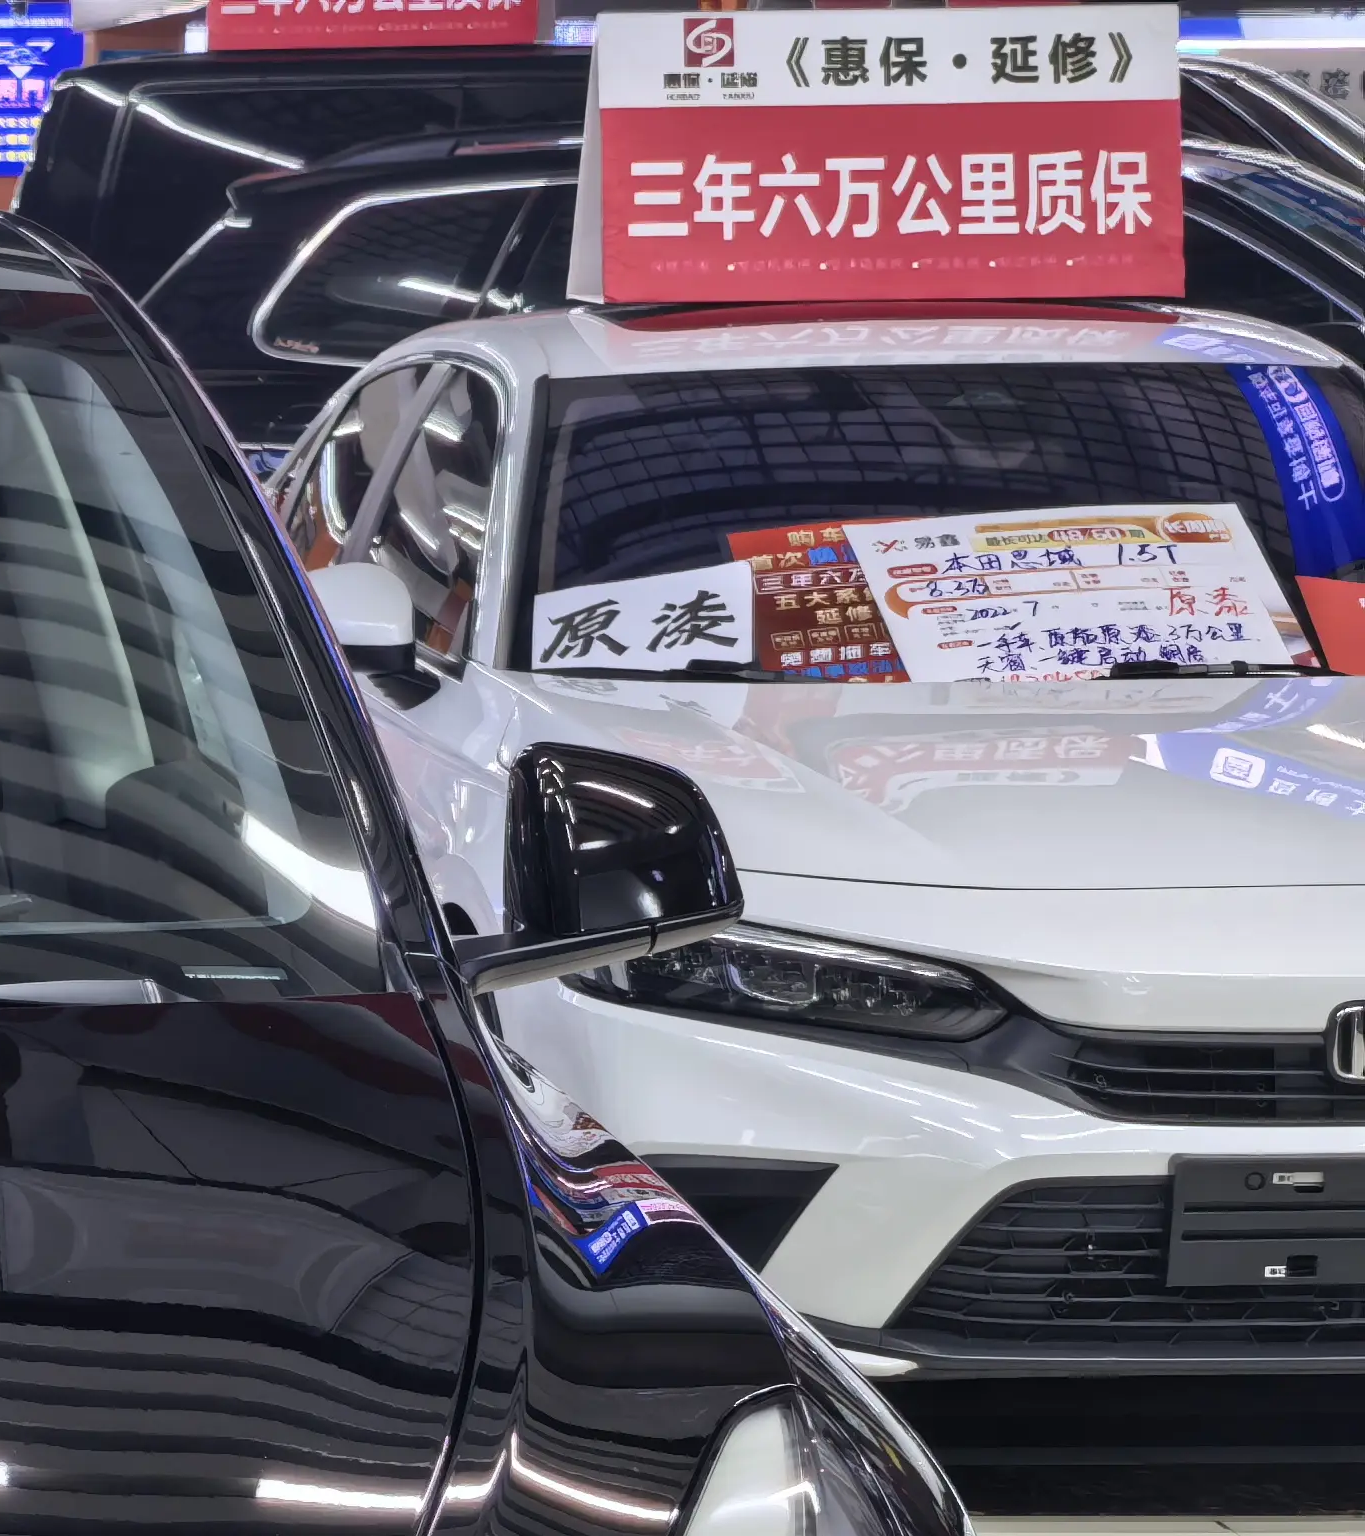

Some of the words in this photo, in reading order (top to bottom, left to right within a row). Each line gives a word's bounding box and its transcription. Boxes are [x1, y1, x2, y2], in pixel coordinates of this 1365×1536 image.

[785, 32, 1136, 89] 《惠保·延修》
[628, 150, 1153, 242] 三年六万公里质保
[1116, 543, 1179, 567] 1.5T
[539, 589, 739, 664] 原漆
